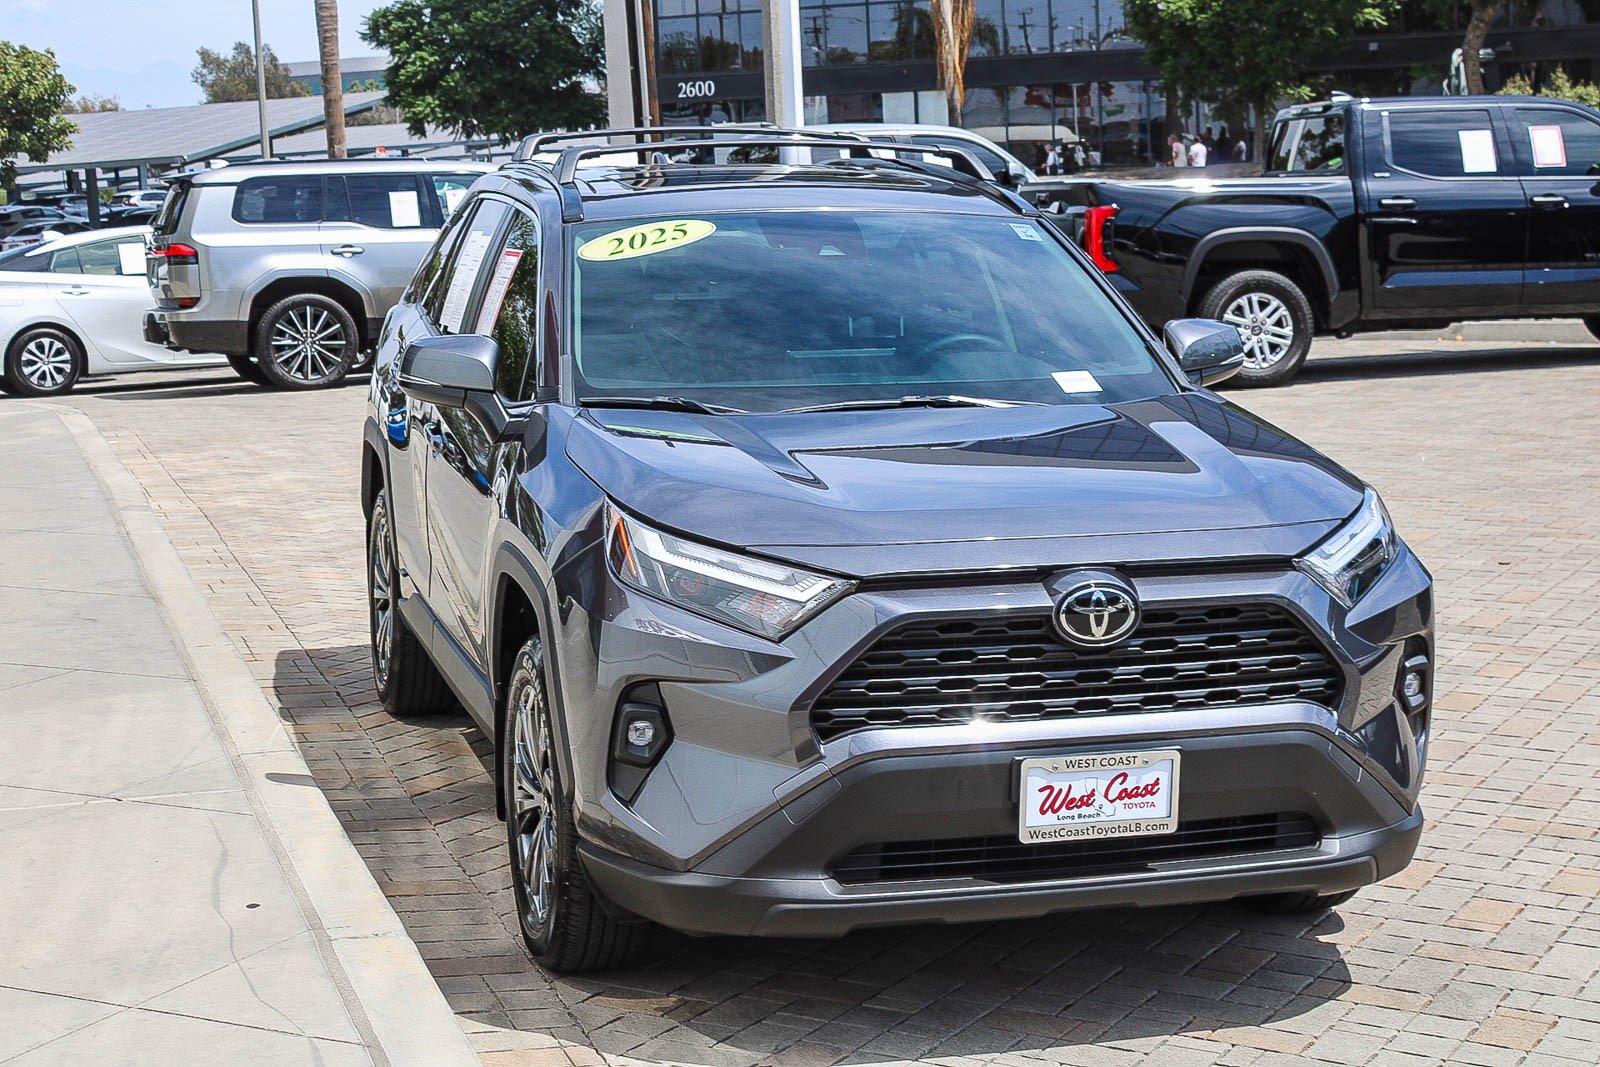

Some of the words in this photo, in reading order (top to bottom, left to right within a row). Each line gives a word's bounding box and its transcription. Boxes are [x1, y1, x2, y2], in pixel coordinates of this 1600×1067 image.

[677, 80, 715, 98] 2600
[607, 223, 688, 256] 2025
[1064, 758, 1097, 769] WEST
[1099, 755, 1138, 767] COAST
[1038, 783, 1096, 816] West
[1103, 771, 1160, 804] Coast
[1122, 801, 1156, 810] TOYOTA
[1056, 813, 1076, 822] Long
[1077, 812, 1101, 820] Beach
[1028, 822, 1170, 840] WestCoastToyotaLB.com
